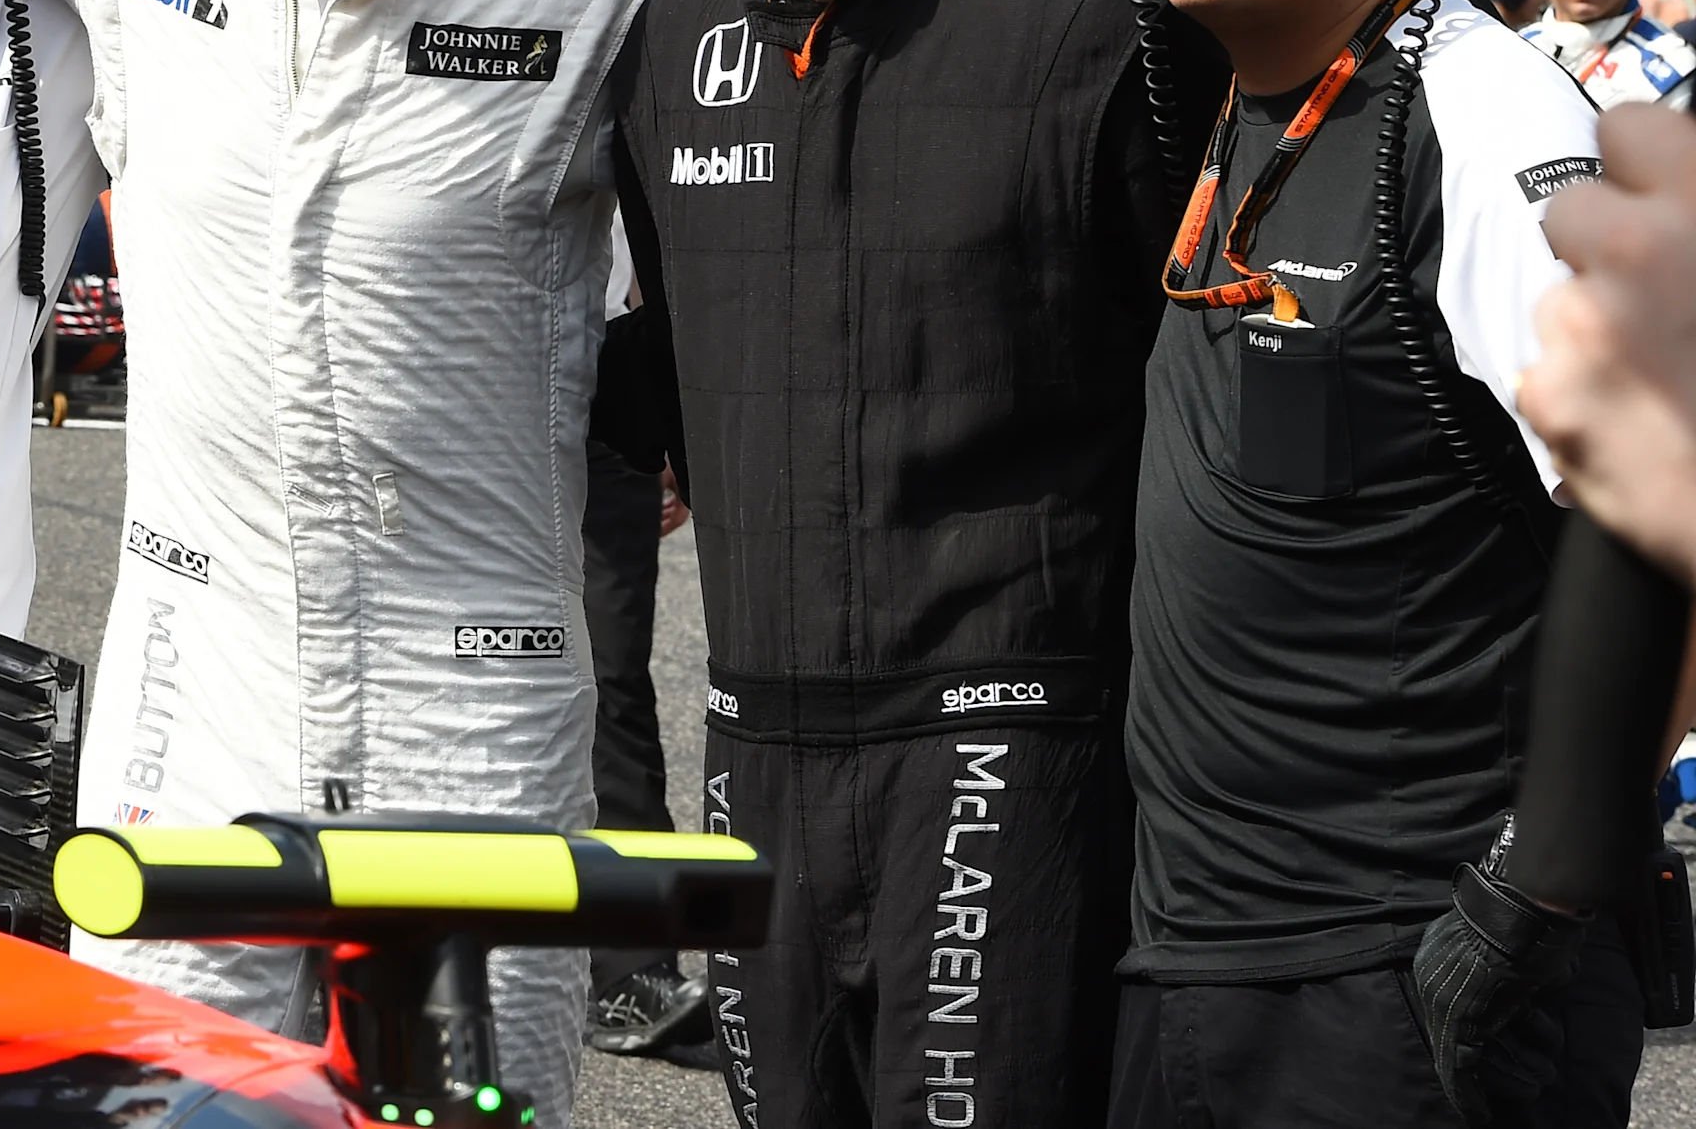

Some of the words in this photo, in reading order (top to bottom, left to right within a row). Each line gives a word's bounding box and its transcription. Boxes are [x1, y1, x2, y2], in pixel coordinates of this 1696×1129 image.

[420, 25, 524, 54] JOHNNIE
[428, 51, 519, 74] WALKER
[671, 145, 742, 185] Mobil
[1523, 160, 1591, 188] JOHNNIE
[1268, 260, 1350, 283] McLaren
[1249, 331, 1281, 352] Kenji
[130, 524, 209, 576] sparco
[456, 628, 563, 654] sparco
[124, 598, 178, 793] BUTTON
[942, 682, 1047, 712] sparco
[928, 744, 1008, 1023] McLAREN
